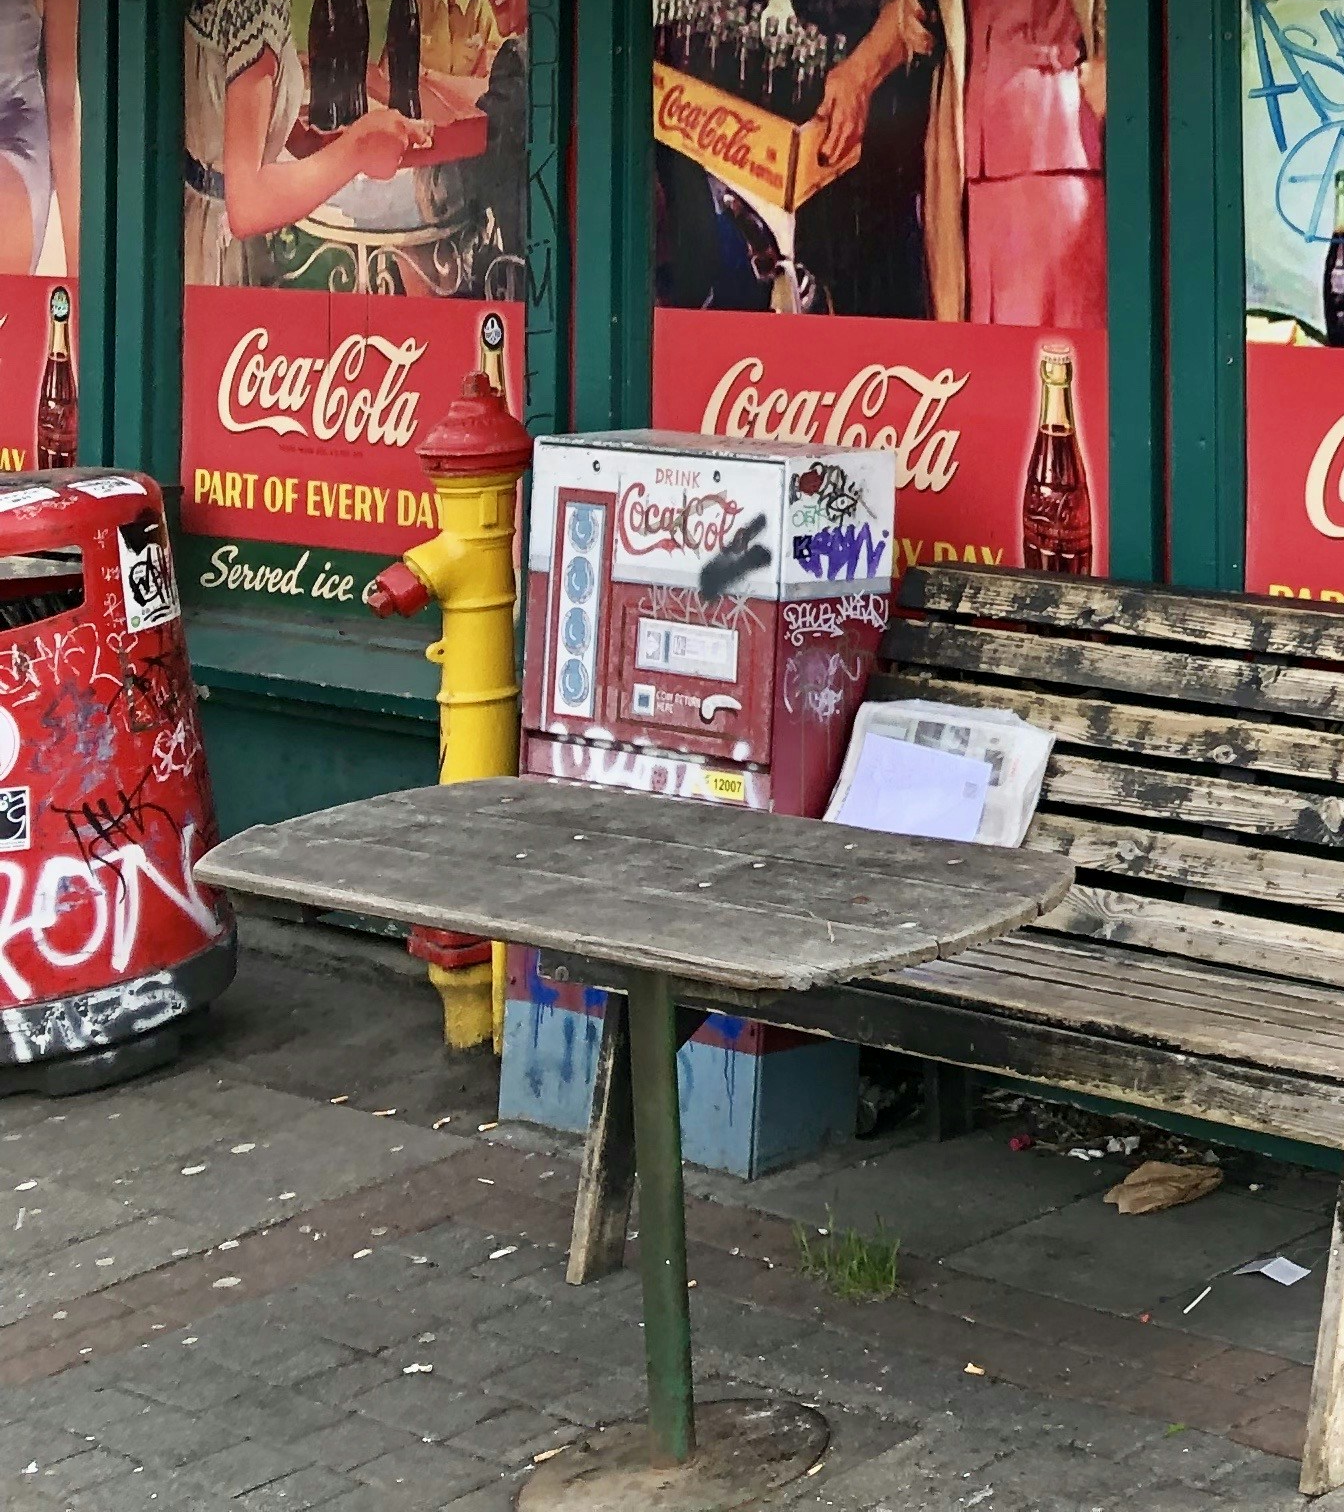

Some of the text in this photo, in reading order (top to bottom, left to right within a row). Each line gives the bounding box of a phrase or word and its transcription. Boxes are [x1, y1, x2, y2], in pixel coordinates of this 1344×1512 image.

[658, 85, 761, 168] Coca-Cola
[217, 326, 428, 449] Coca-Cola
[194, 468, 258, 510] PART
[263, 476, 298, 514] OF
[306, 480, 390, 524] EVERY
[655, 467, 700, 488] DRINK
[200, 545, 310, 595] Served
[311, 561, 354, 600] ice
[713, 778, 742, 793] 12007
